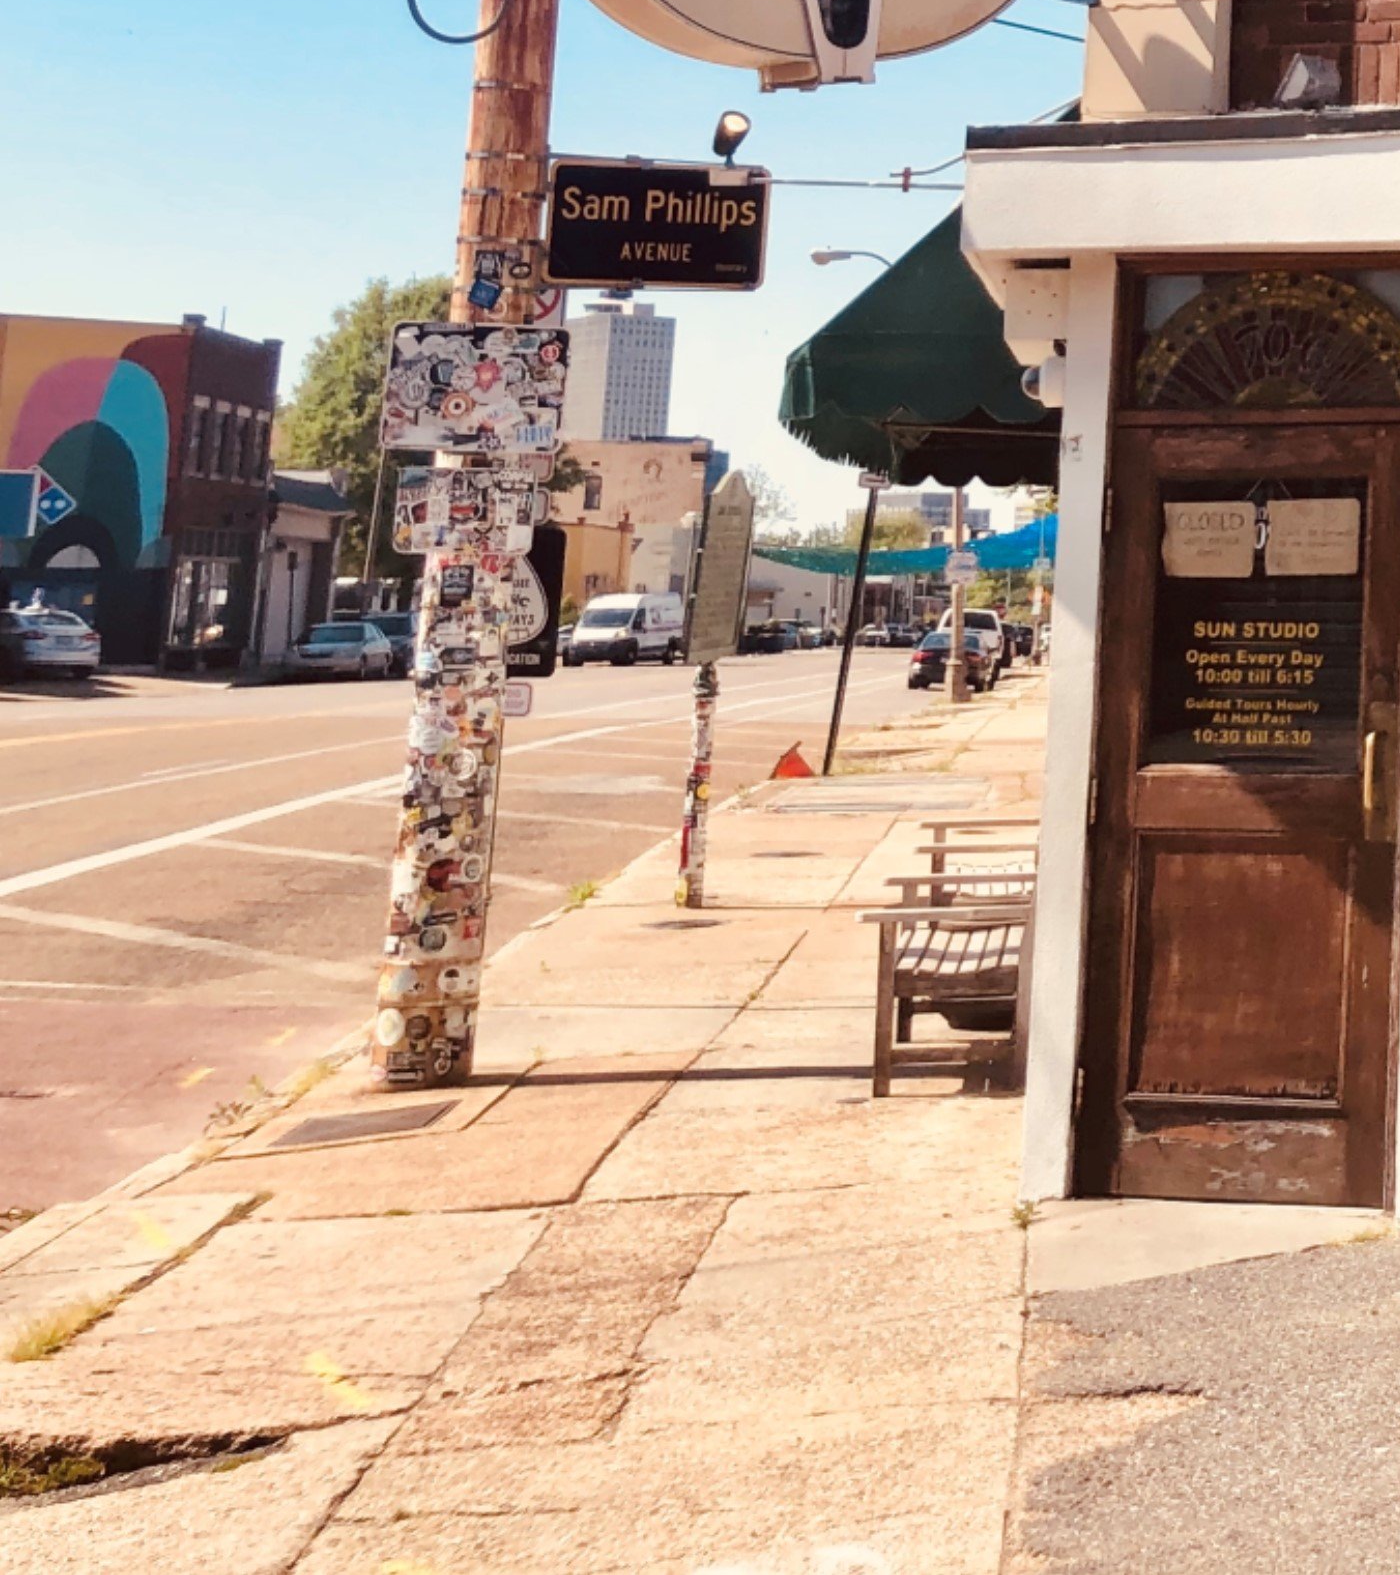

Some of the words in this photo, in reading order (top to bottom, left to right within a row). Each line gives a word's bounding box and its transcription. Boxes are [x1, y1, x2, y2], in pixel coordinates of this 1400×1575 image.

[561, 185, 630, 222] Sam
[645, 189, 757, 233] Phillips
[620, 241, 693, 262] AVENUE
[1194, 621, 1236, 638] SUN
[1242, 622, 1320, 638] STUDIO
[1185, 649, 1231, 666] Open
[1236, 649, 1285, 667] Every
[1291, 649, 1324, 667] Day
[1195, 668, 1243, 683] 10:00
[1248, 668, 1271, 683] till
[1276, 669, 1314, 684] 6:15
[1185, 696, 1231, 710] Guided
[1235, 698, 1272, 710] Tours
[1277, 699, 1320, 714] Hourly
[1212, 713, 1227, 723] At
[1231, 713, 1259, 723] Half
[1262, 713, 1292, 724] Past
[1192, 728, 1240, 744] 10:30
[1245, 729, 1268, 744] till
[1274, 729, 1311, 745] 5:30
